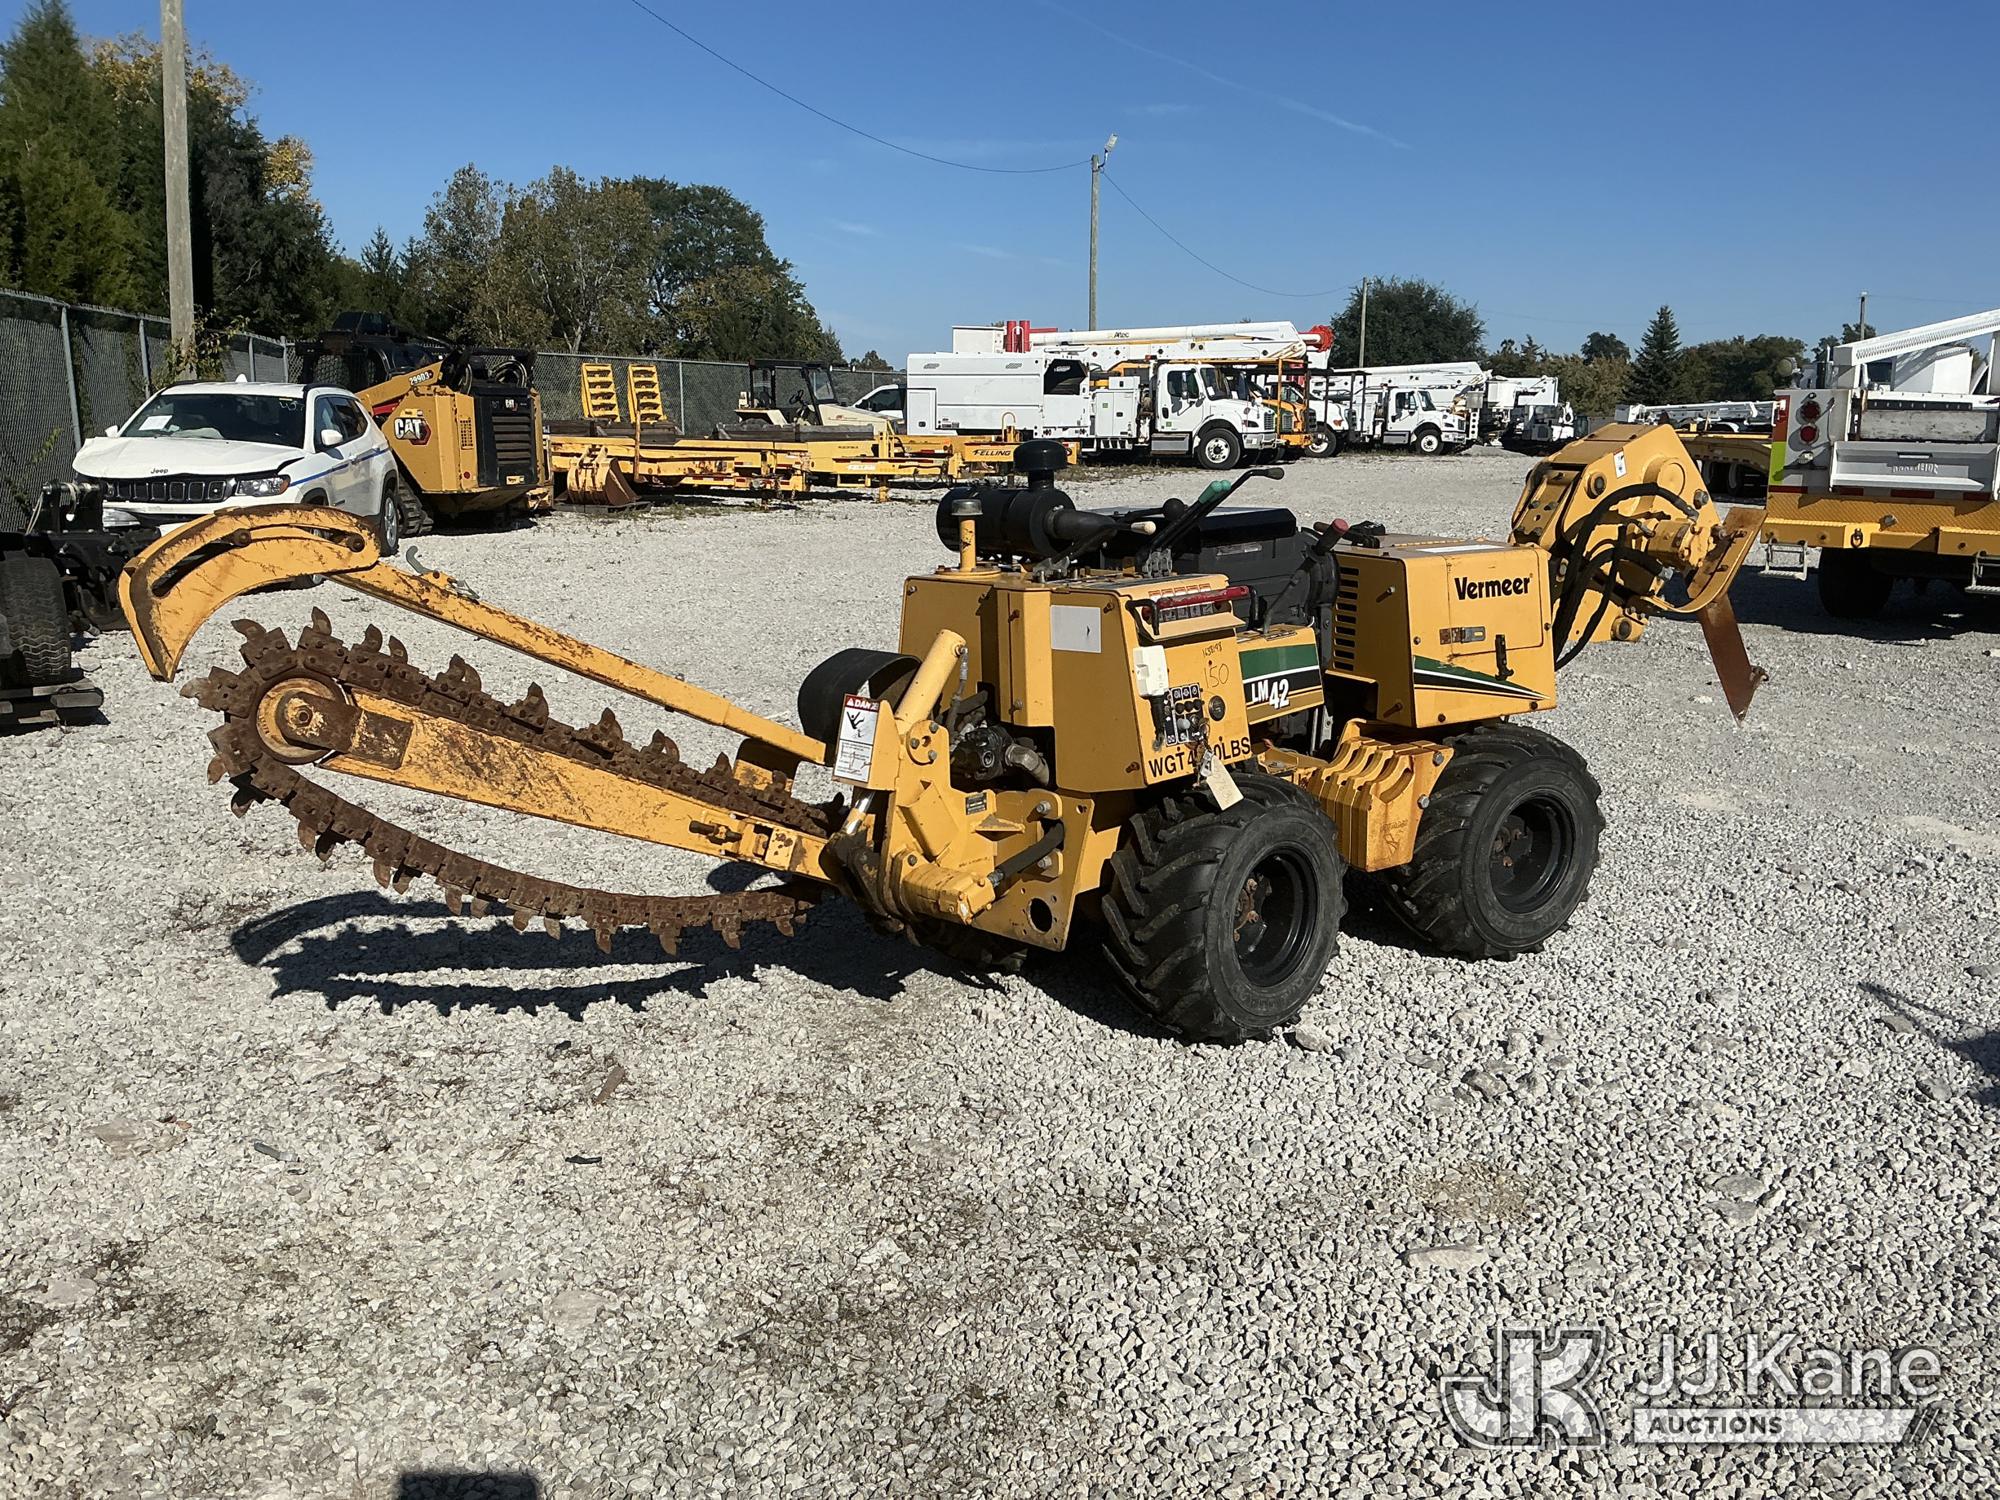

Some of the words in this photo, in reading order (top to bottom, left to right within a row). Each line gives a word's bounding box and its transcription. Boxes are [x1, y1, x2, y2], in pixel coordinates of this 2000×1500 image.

[394, 418, 422, 440] CAT
[150, 467, 169, 475] Jeep
[1453, 576, 1531, 601] Vermeer
[1203, 663, 1230, 689] 150
